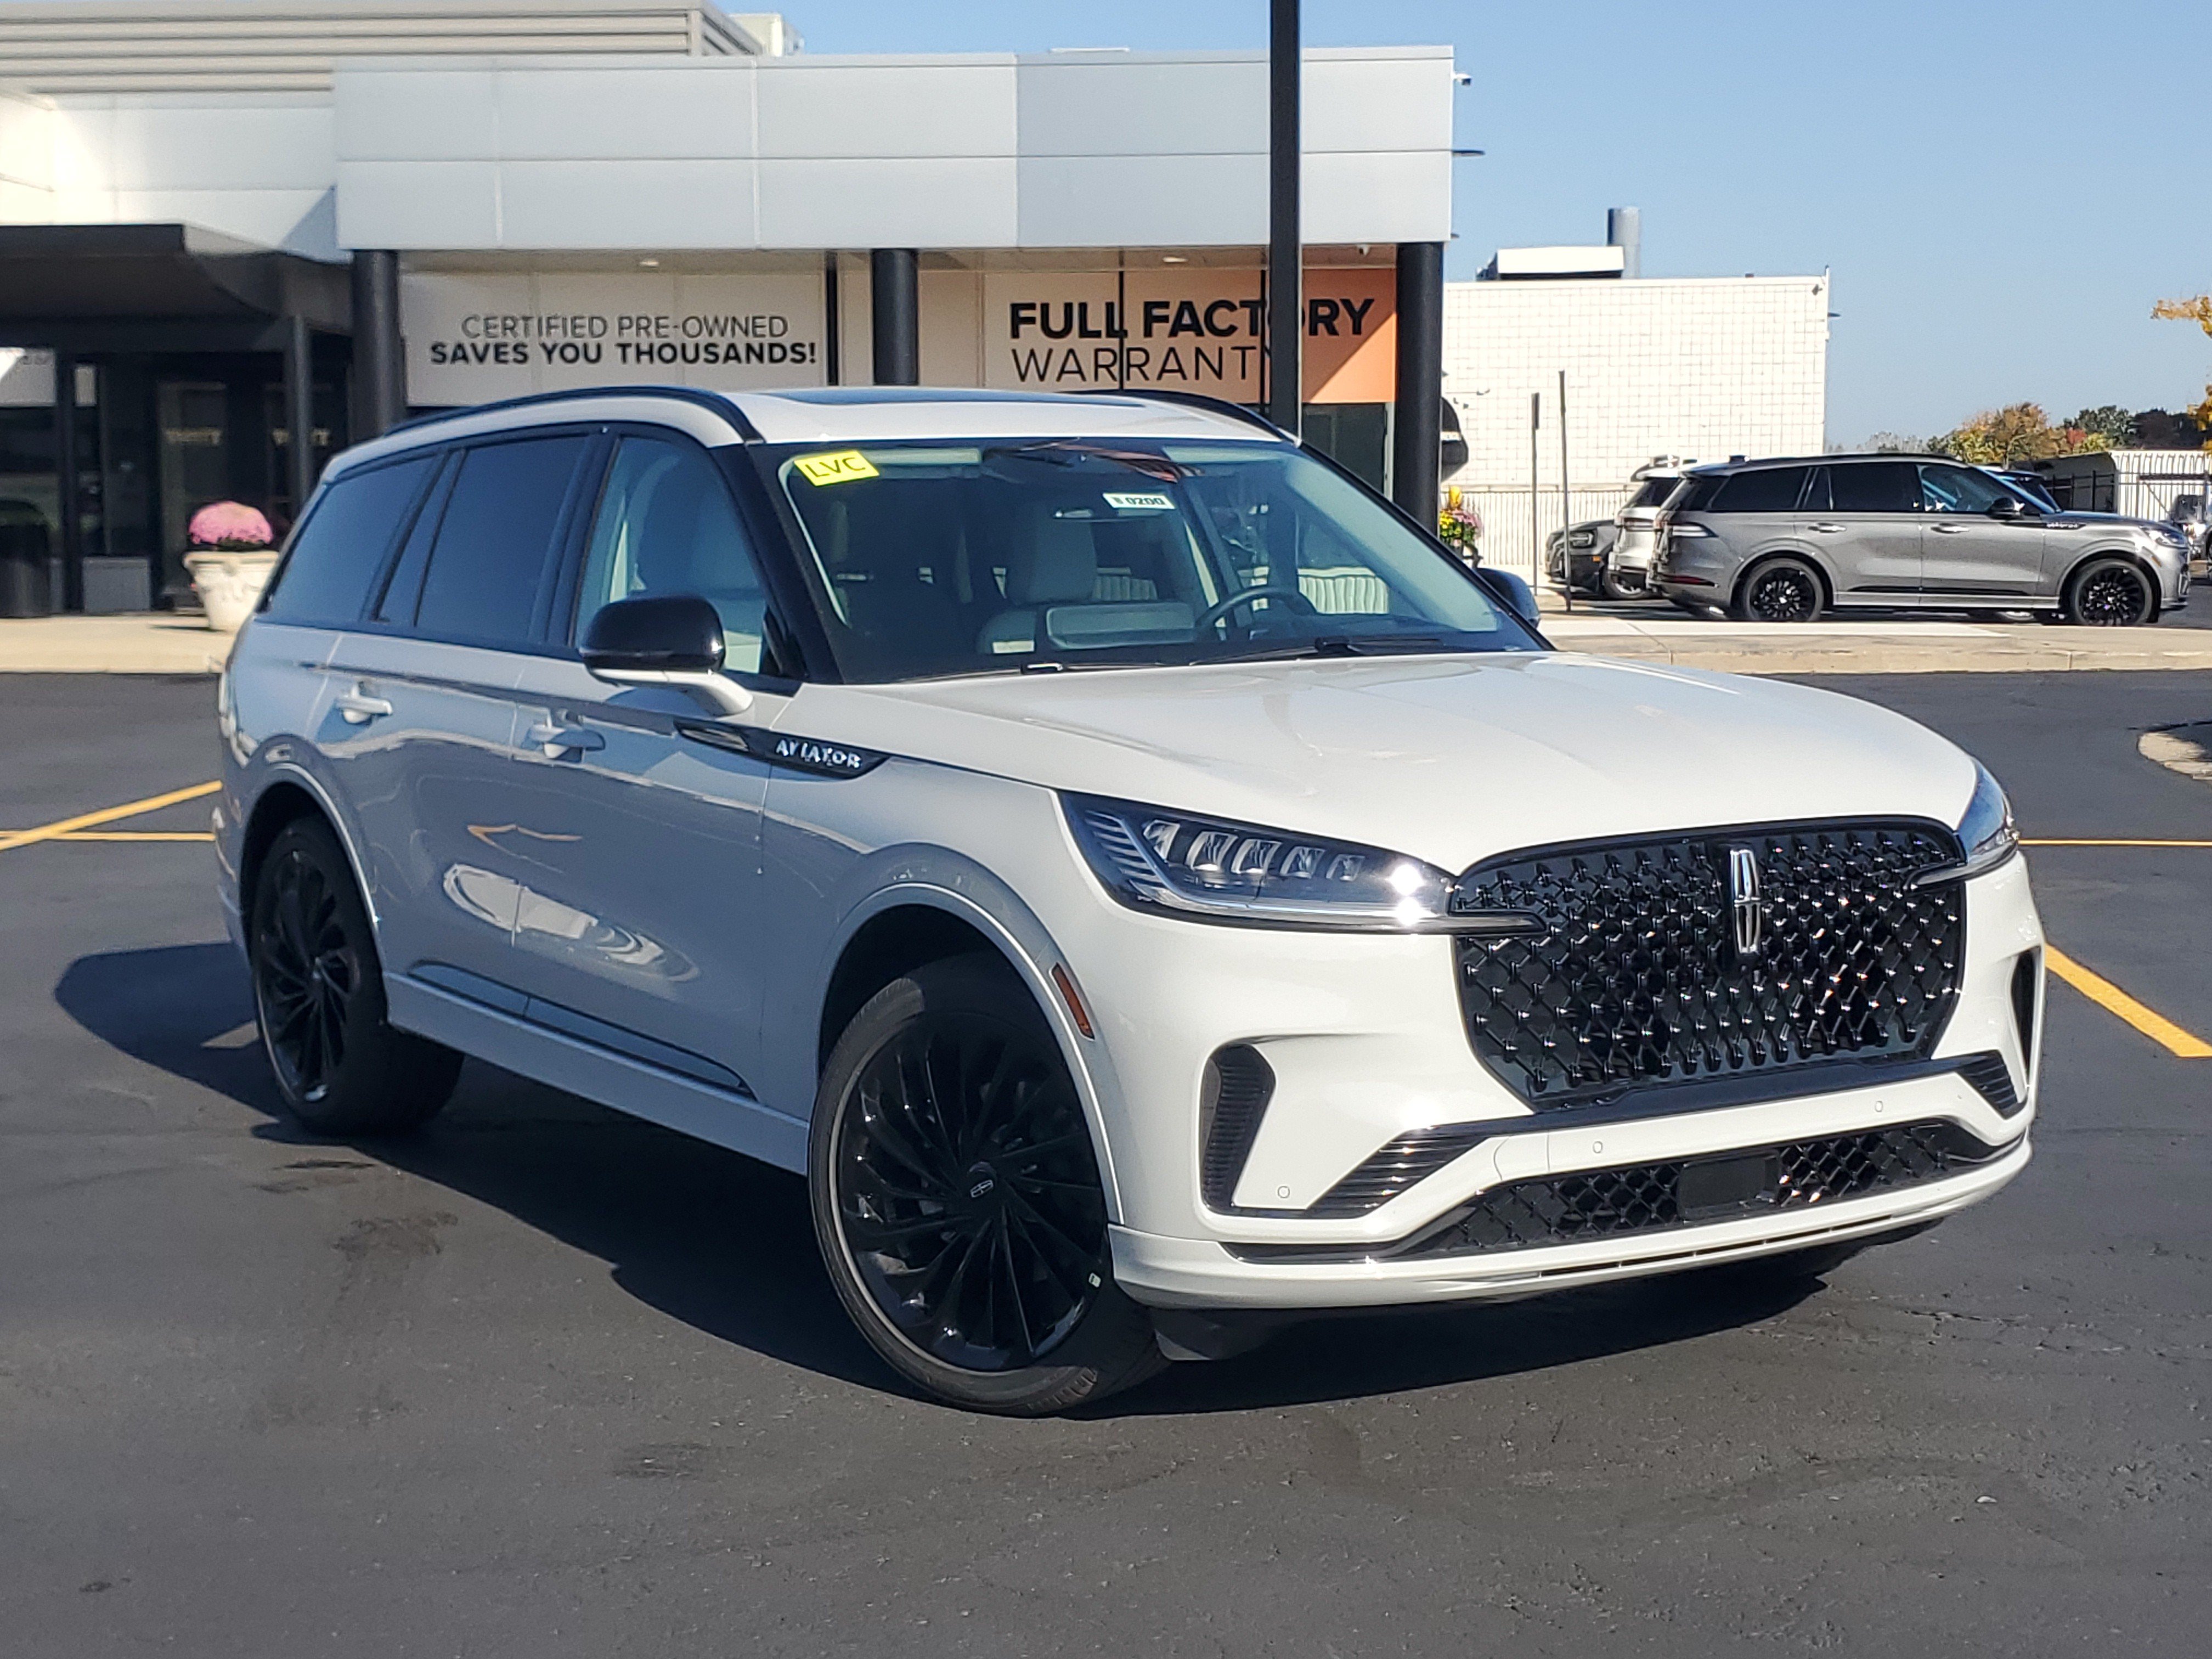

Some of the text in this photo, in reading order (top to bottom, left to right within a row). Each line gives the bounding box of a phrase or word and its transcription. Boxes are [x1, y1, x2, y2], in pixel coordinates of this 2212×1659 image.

[461, 315, 788, 338] CERTIFIED PRE-OWNED
[1010, 299, 1375, 339] FULL FACTRY
[431, 342, 816, 364] SAVES YOU THOUSANDS!
[1011, 346, 1271, 382] WARRANT
[805, 457, 866, 478] LVC
[775, 739, 862, 768] AVIATOR
